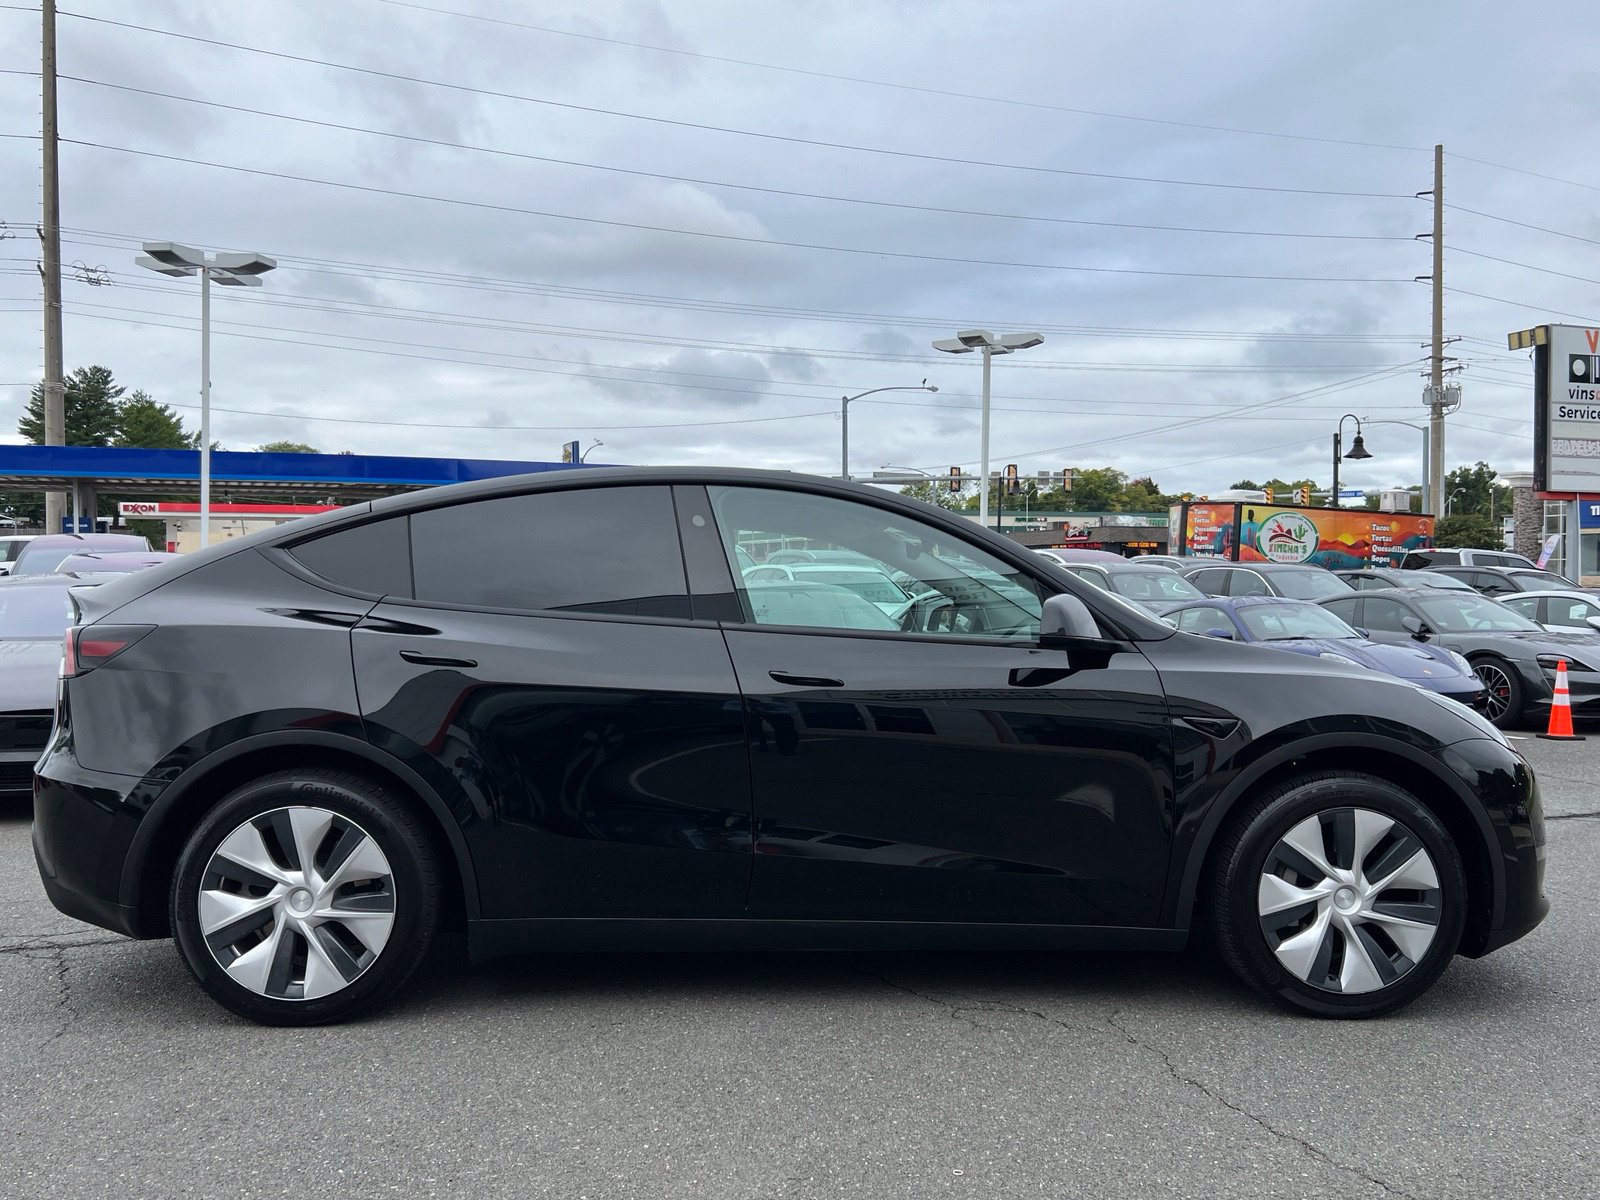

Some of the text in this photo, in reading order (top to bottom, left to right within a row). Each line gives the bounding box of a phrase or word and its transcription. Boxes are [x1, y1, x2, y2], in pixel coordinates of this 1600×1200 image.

[122, 504, 156, 515] EXXON
[1371, 523, 1390, 531] Tacos
[1371, 534, 1392, 542] Tortas
[1268, 543, 1307, 554] XIMENA'S
[1371, 544, 1409, 553] Quesadillas
[1371, 555, 1390, 563] Sopes
